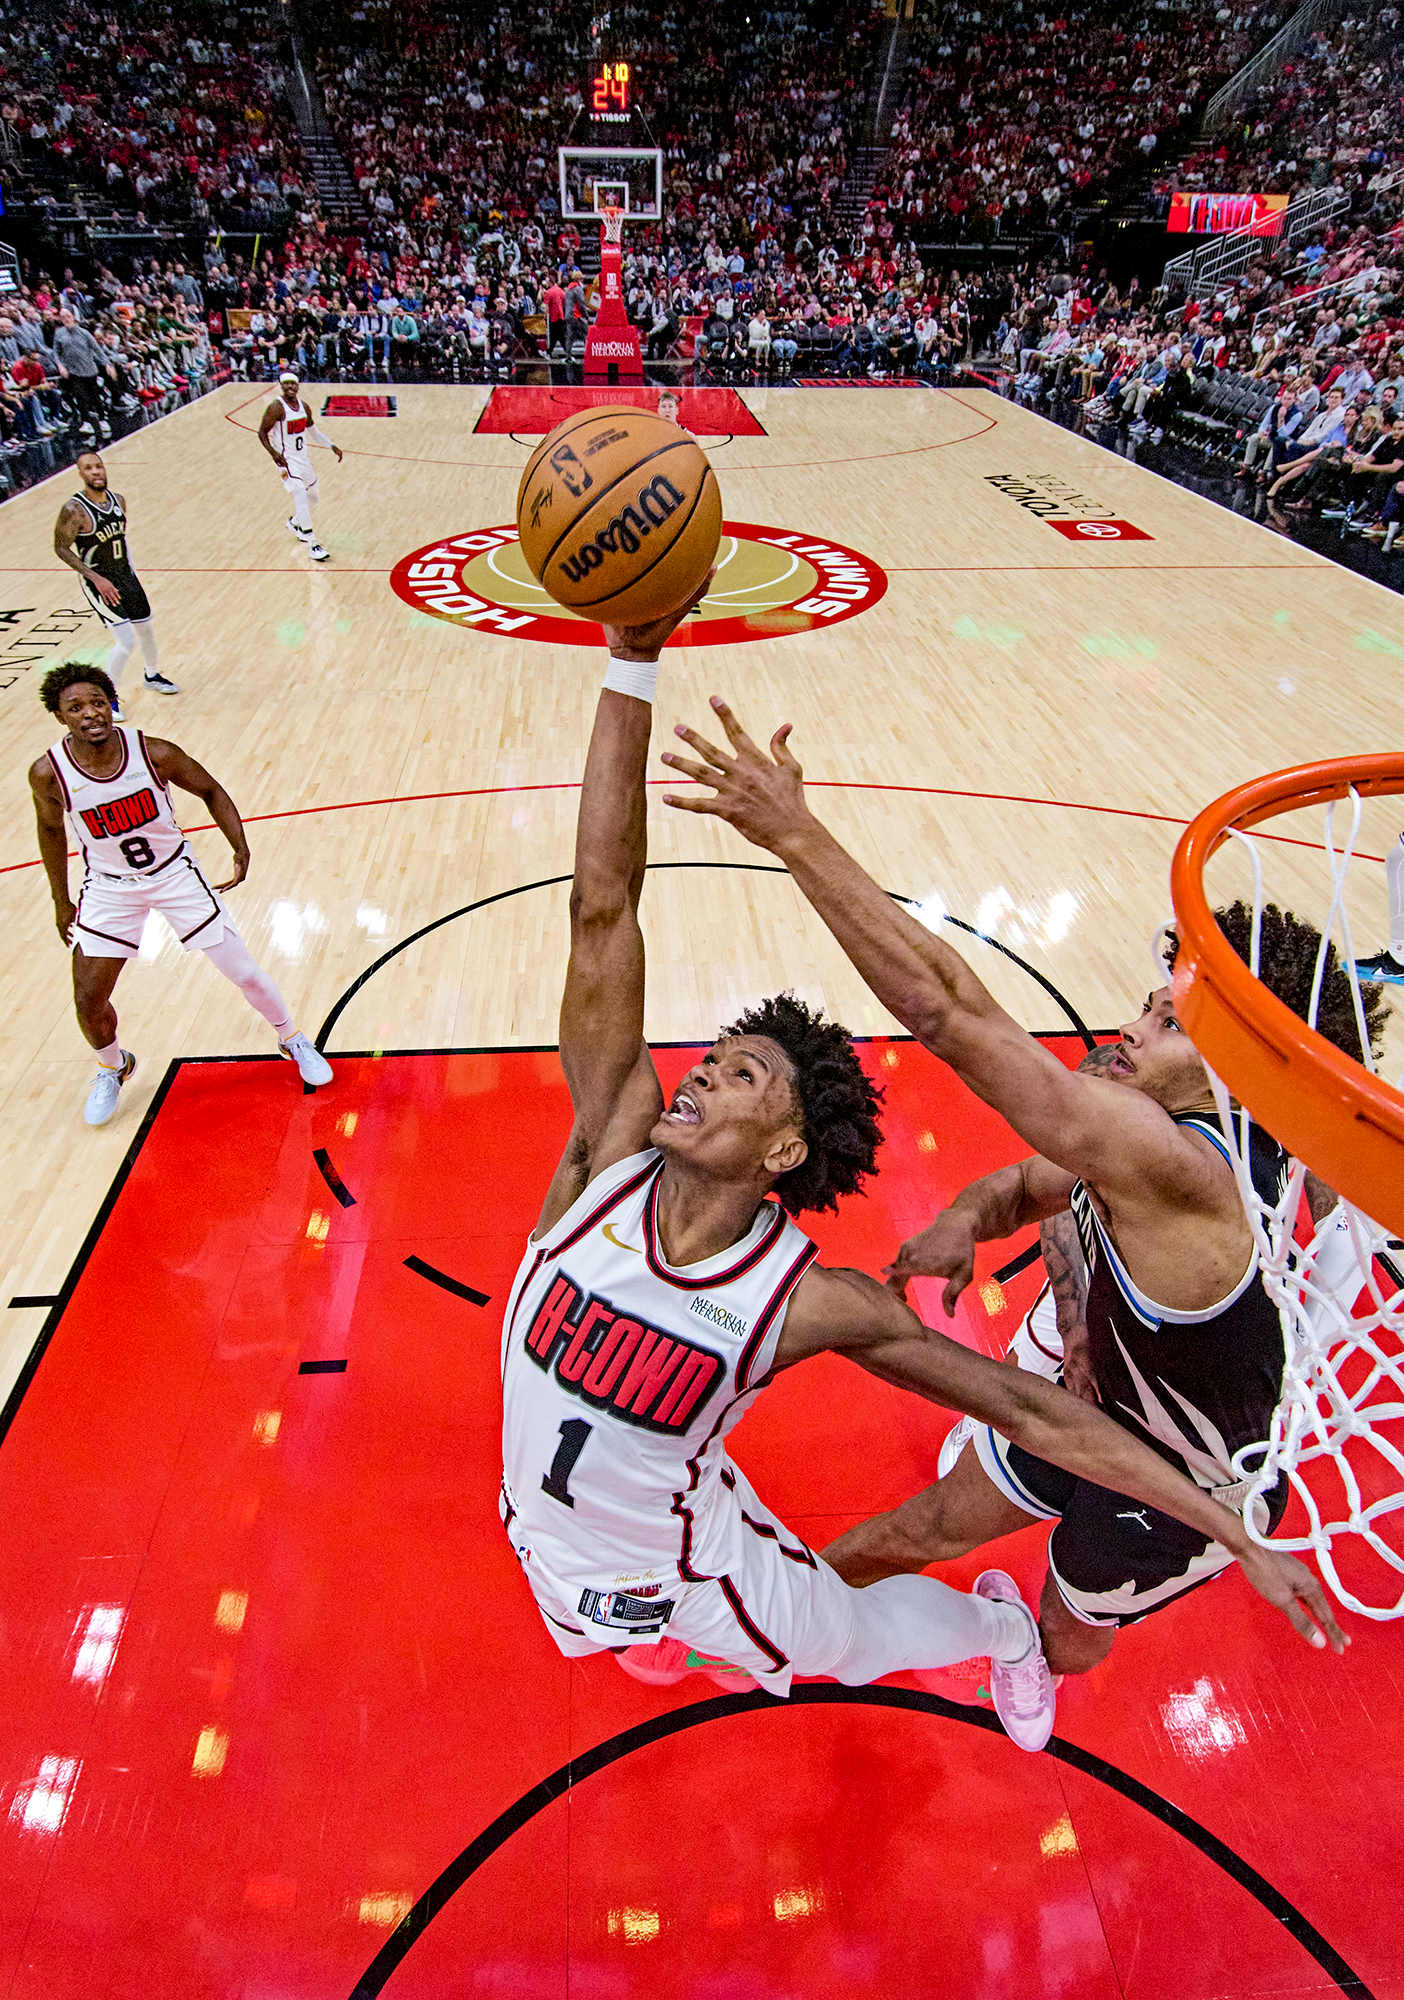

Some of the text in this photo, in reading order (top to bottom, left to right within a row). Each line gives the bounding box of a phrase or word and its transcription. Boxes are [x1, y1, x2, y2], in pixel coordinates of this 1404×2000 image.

[593, 79, 626, 110] 24
[601, 113, 631, 123] TISSOT
[592, 341, 633, 351] MEMORIAL
[592, 347, 634, 357] HERMANN
[295, 436, 304, 451] 0
[983, 474, 1069, 517] TOYOTA
[1026, 474, 1116, 517] CENTER
[558, 473, 687, 583] Wilson
[112, 539, 123, 559] 0
[757, 535, 871, 618] SUMMIT
[119, 836, 156, 870] 8
[689, 1302, 744, 1337] HERMANN
[691, 1296, 748, 1332] MEMORIAL
[524, 1268, 727, 1437] H-TOWN
[541, 1417, 594, 1512] 1
